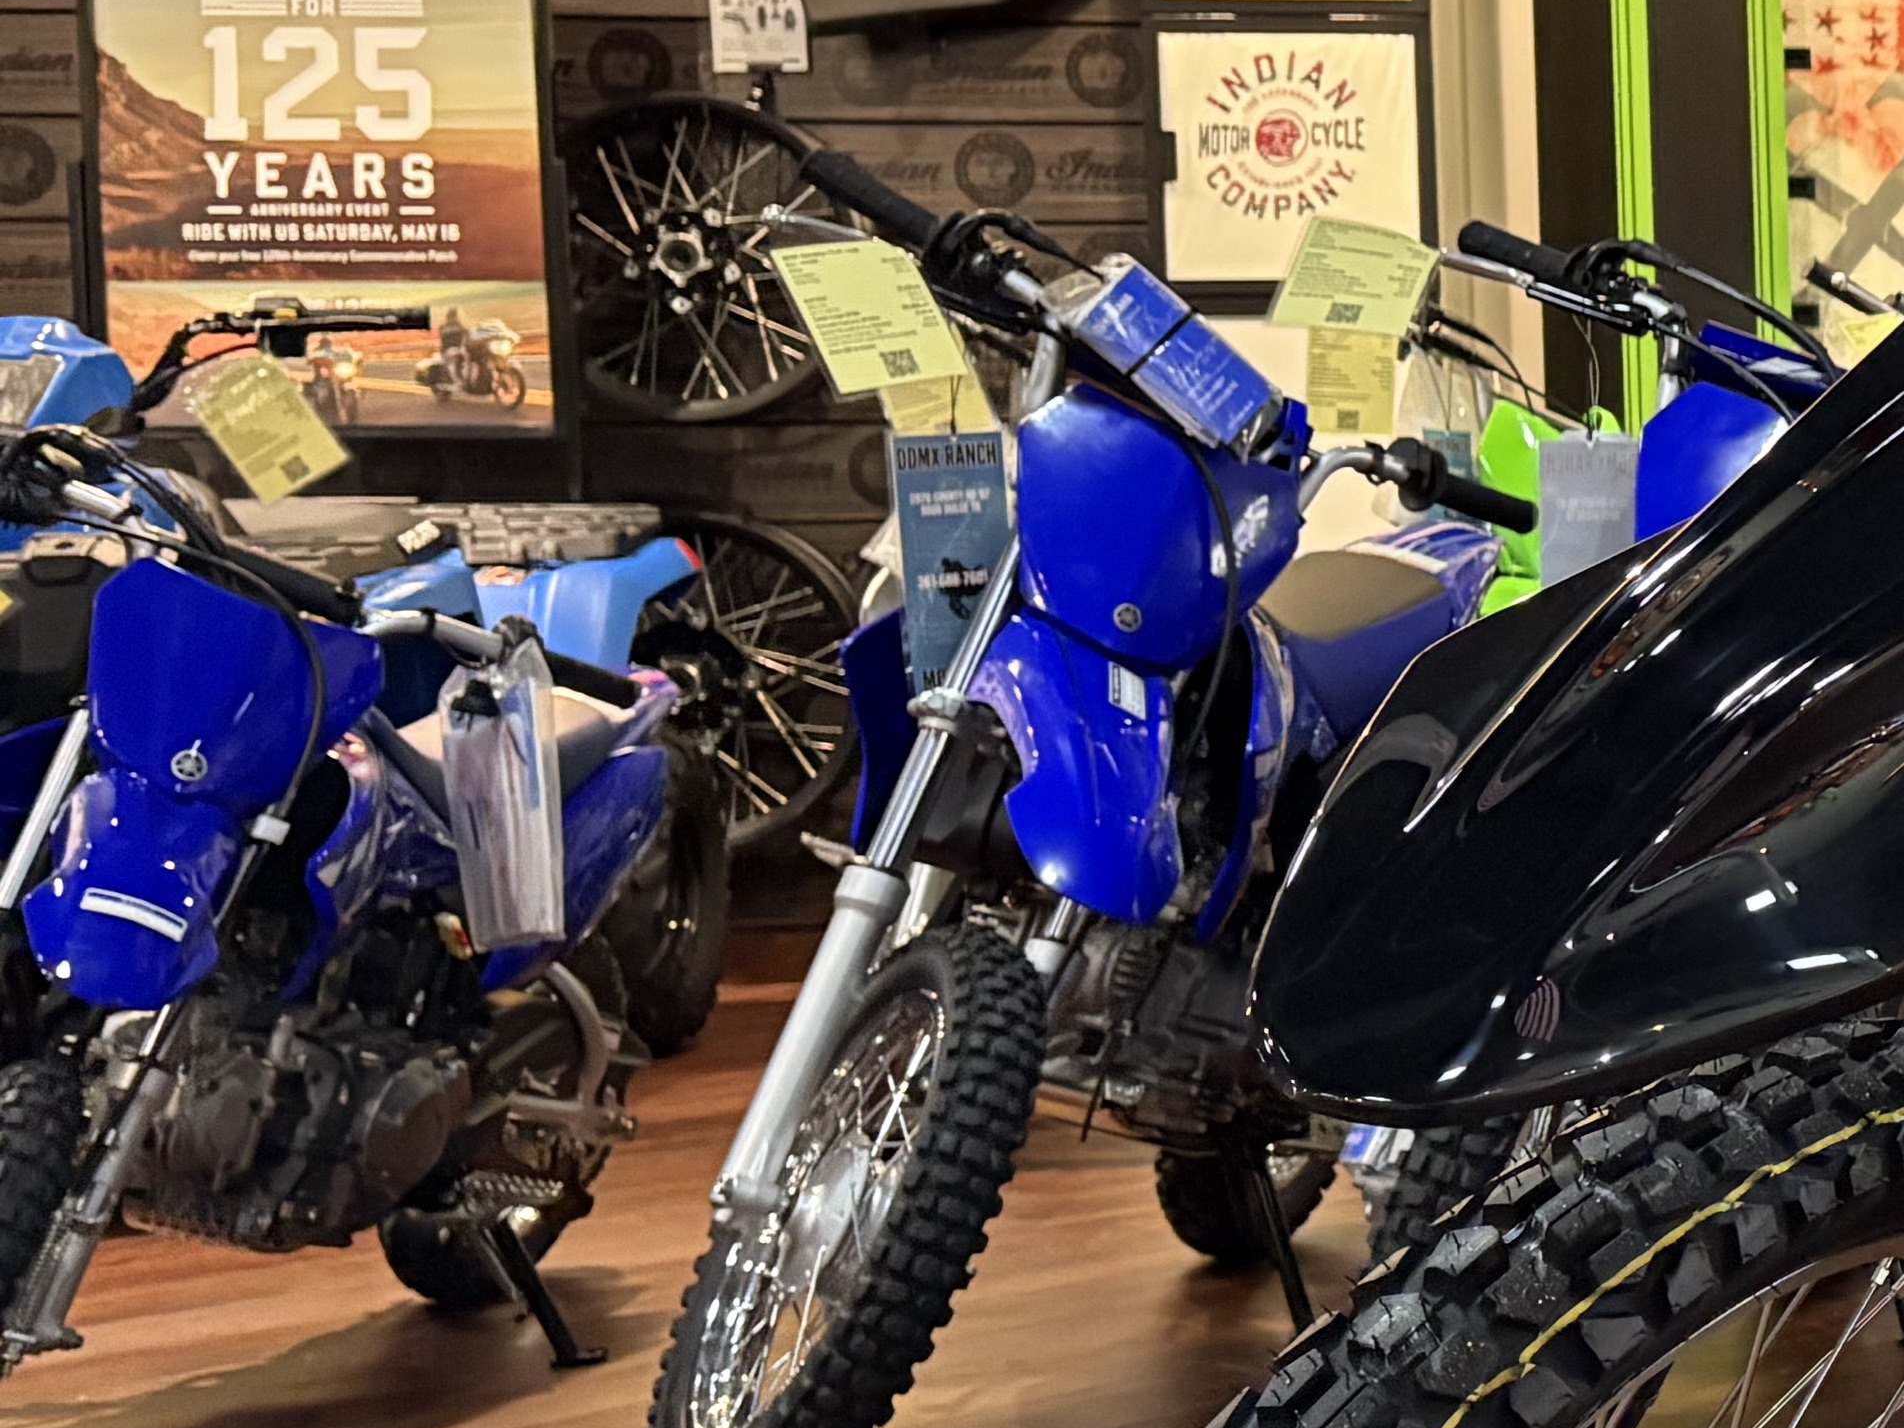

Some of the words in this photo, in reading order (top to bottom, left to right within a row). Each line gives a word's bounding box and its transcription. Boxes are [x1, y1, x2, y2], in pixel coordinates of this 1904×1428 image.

[202, 26, 432, 142] 125
[1206, 50, 1358, 114] INDIAN
[1198, 121, 1251, 159] MOTOR
[1310, 117, 1365, 152] CYCLE
[202, 151, 435, 200] YEARS
[181, 222, 226, 242] RIDE
[227, 222, 272, 242] WITH
[274, 222, 300, 242] US
[302, 222, 399, 244] SATURDAY,
[400, 222, 438, 242] MAY
[945, 442, 997, 466] RANCH
